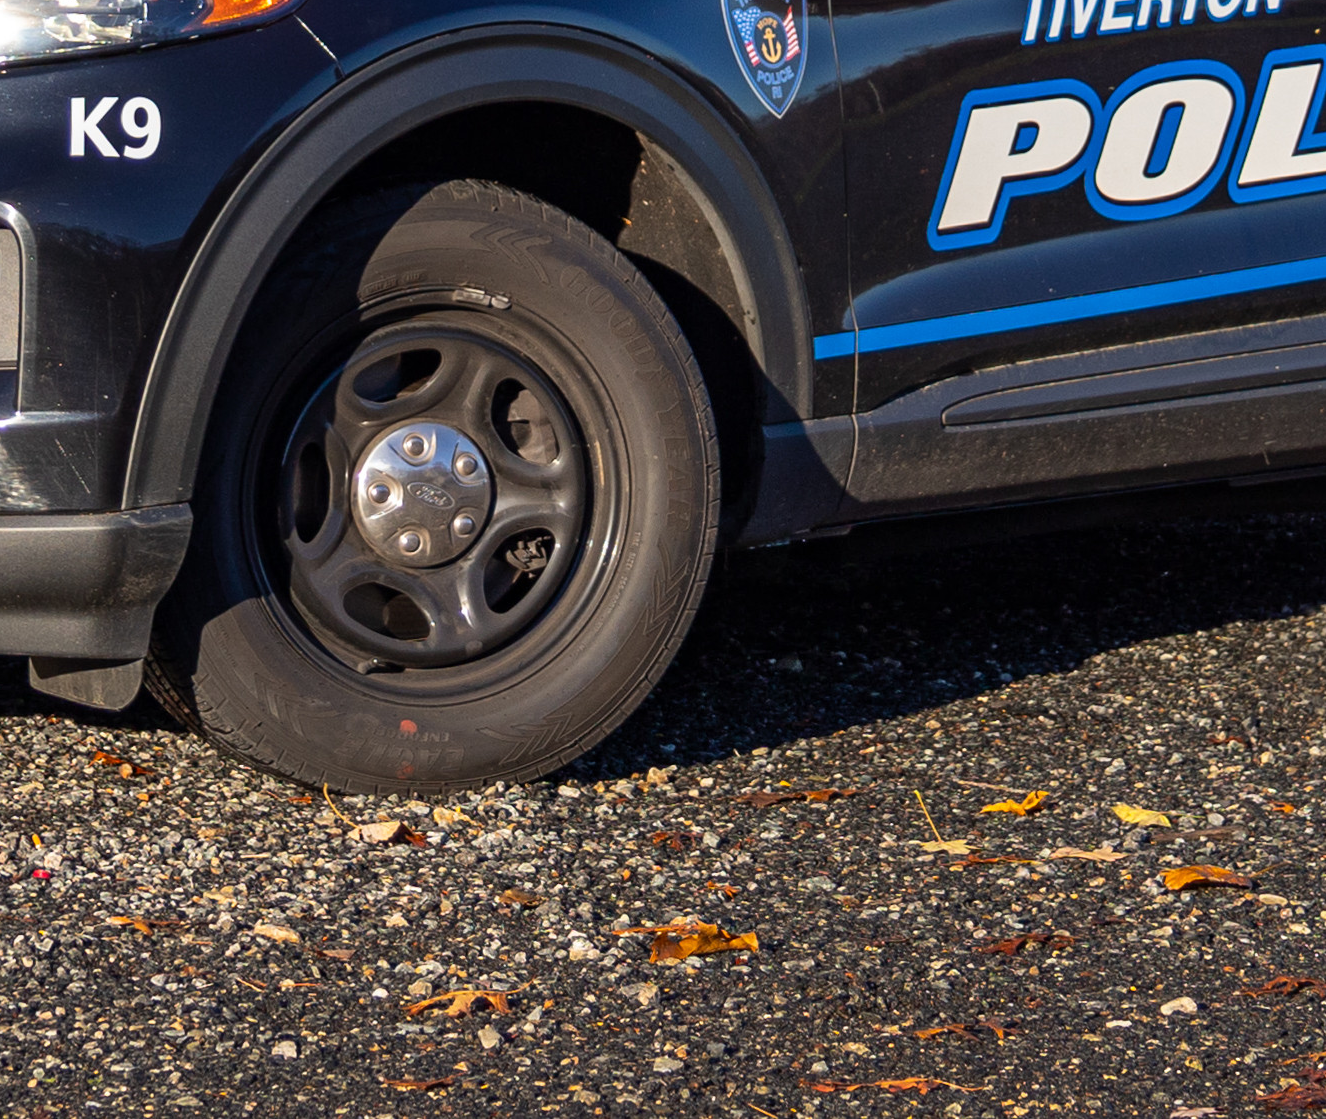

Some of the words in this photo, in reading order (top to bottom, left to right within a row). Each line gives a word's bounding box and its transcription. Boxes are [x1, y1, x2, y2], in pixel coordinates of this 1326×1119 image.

[757, 66, 794, 85] POLICE
[772, 86, 782, 99] RI
[69, 96, 162, 160] K9
[560, 265, 693, 532] GOODYEAR
